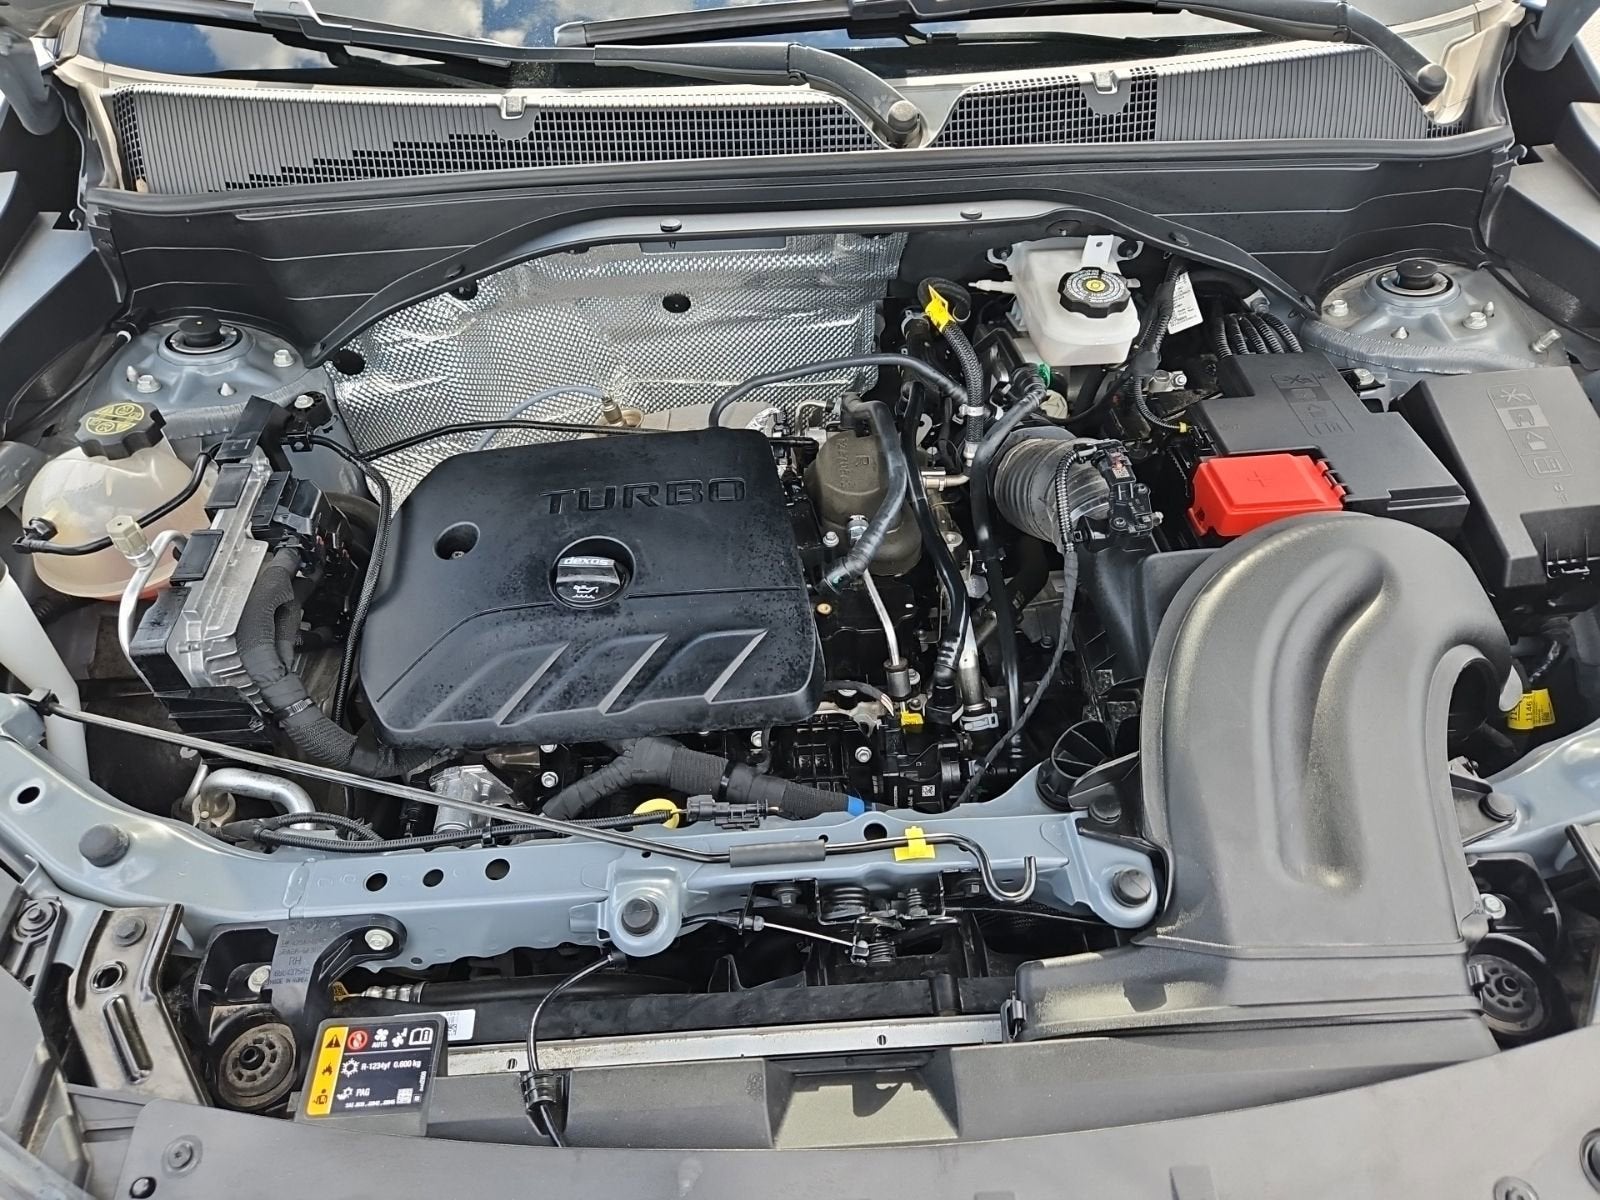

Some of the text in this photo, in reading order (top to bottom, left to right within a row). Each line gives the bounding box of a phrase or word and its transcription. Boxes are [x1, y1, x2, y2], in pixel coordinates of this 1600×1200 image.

[539, 477, 746, 514] TURBO
[563, 556, 609, 566] dexos
[371, 1041, 388, 1049] AUTO
[360, 1061, 391, 1071] R-1234yf
[412, 1059, 422, 1069] kg
[355, 1087, 371, 1097] PAG
